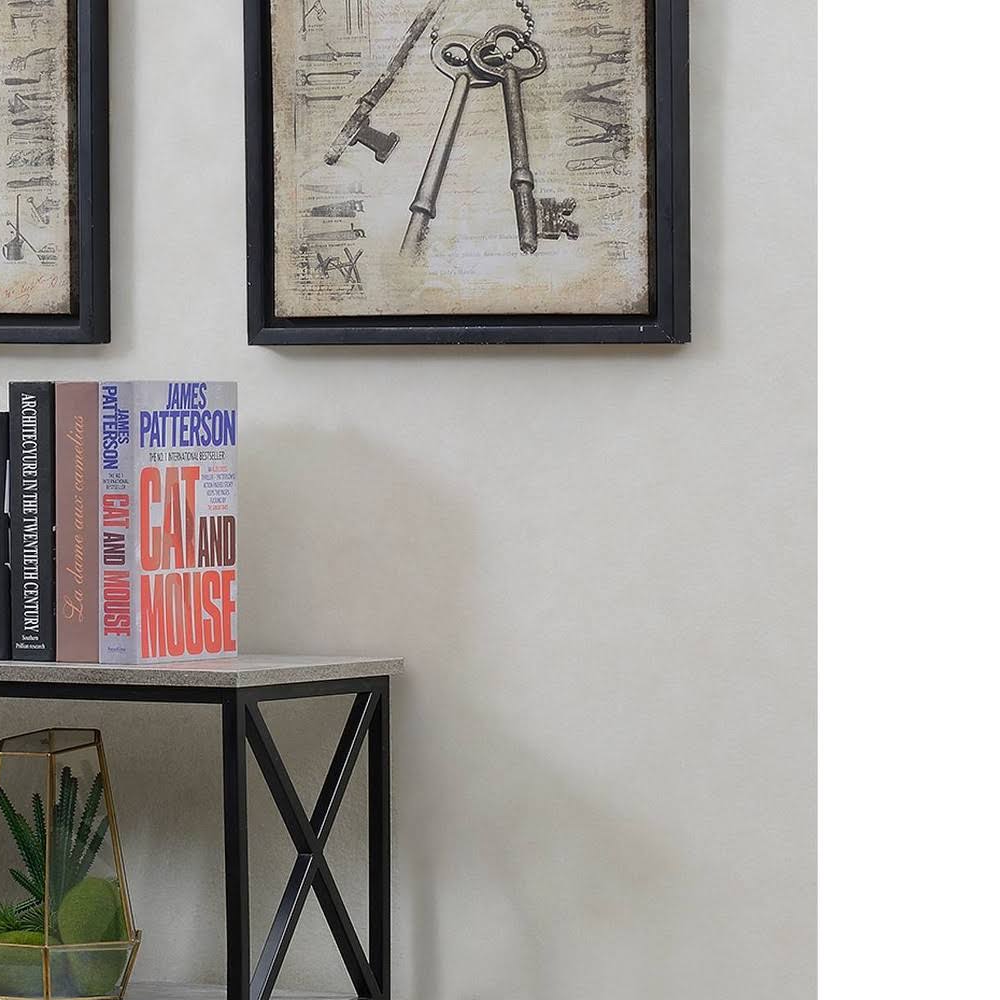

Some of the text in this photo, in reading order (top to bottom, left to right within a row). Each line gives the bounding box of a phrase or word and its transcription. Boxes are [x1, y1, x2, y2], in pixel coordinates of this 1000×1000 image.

[166, 383, 207, 409] JAMES
[102, 385, 118, 469] PATTERSON
[117, 409, 129, 444] JAMES
[140, 410, 236, 448] PATTERSON
[23, 479, 37, 490] IN
[23, 492, 38, 514] THE
[72, 495, 84, 530] aux
[103, 494, 130, 529] CAT
[140, 466, 200, 571] CAT
[23, 516, 39, 579] TWENTIETH
[66, 535, 84, 584] dame
[103, 532, 125, 565] AND
[198, 515, 236, 568] AND
[23, 582, 40, 633] CENTURY
[63, 588, 85, 622] La
[103, 570, 130, 636] MOUSE
[141, 569, 237, 659] MOUSE
